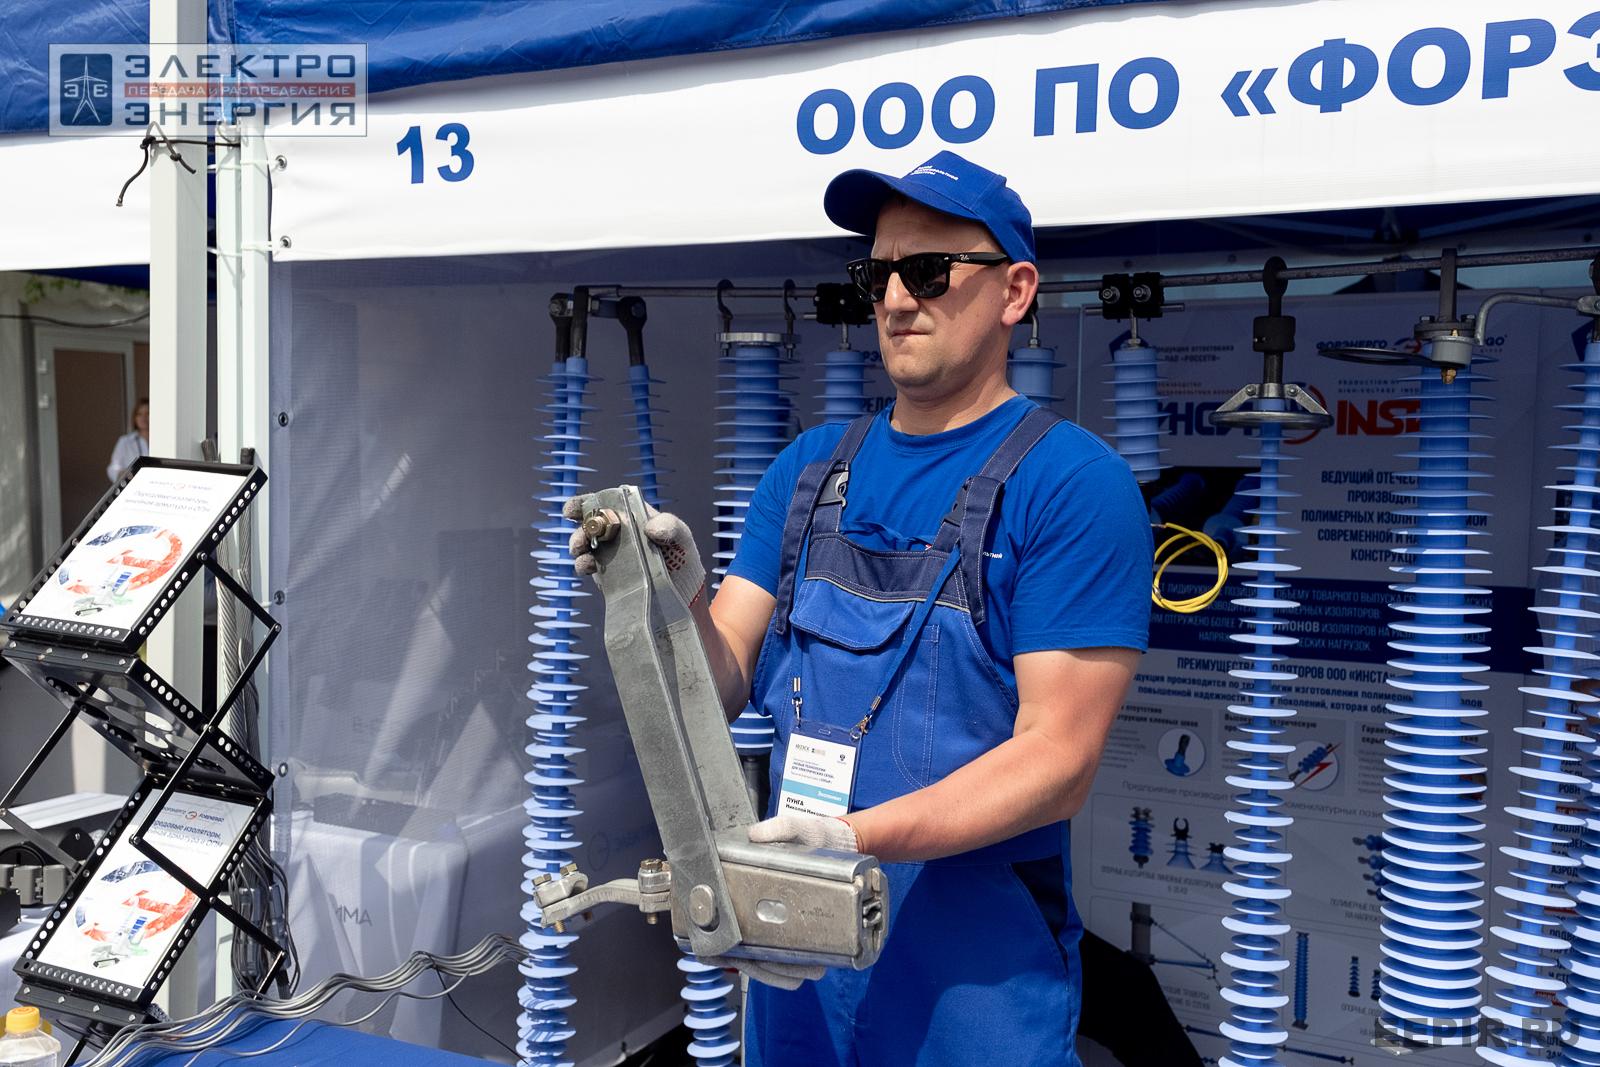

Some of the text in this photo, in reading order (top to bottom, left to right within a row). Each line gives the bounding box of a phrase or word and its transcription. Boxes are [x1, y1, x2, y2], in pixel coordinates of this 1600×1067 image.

[796, 75, 996, 155] ООО
[1033, 57, 1180, 137] ПО
[396, 123, 475, 184] 13
[1321, 469, 1419, 485] ВЕДУЩИЙ ОТЕЧЕС
[1301, 509, 1375, 524] ПОЛИМЕРНЫХ
[1377, 511, 1418, 525] ИЗОЛЯТ
[1318, 528, 1392, 543] СОВРЕМЕННОЙ
[1326, 667, 1347, 681] ООО
